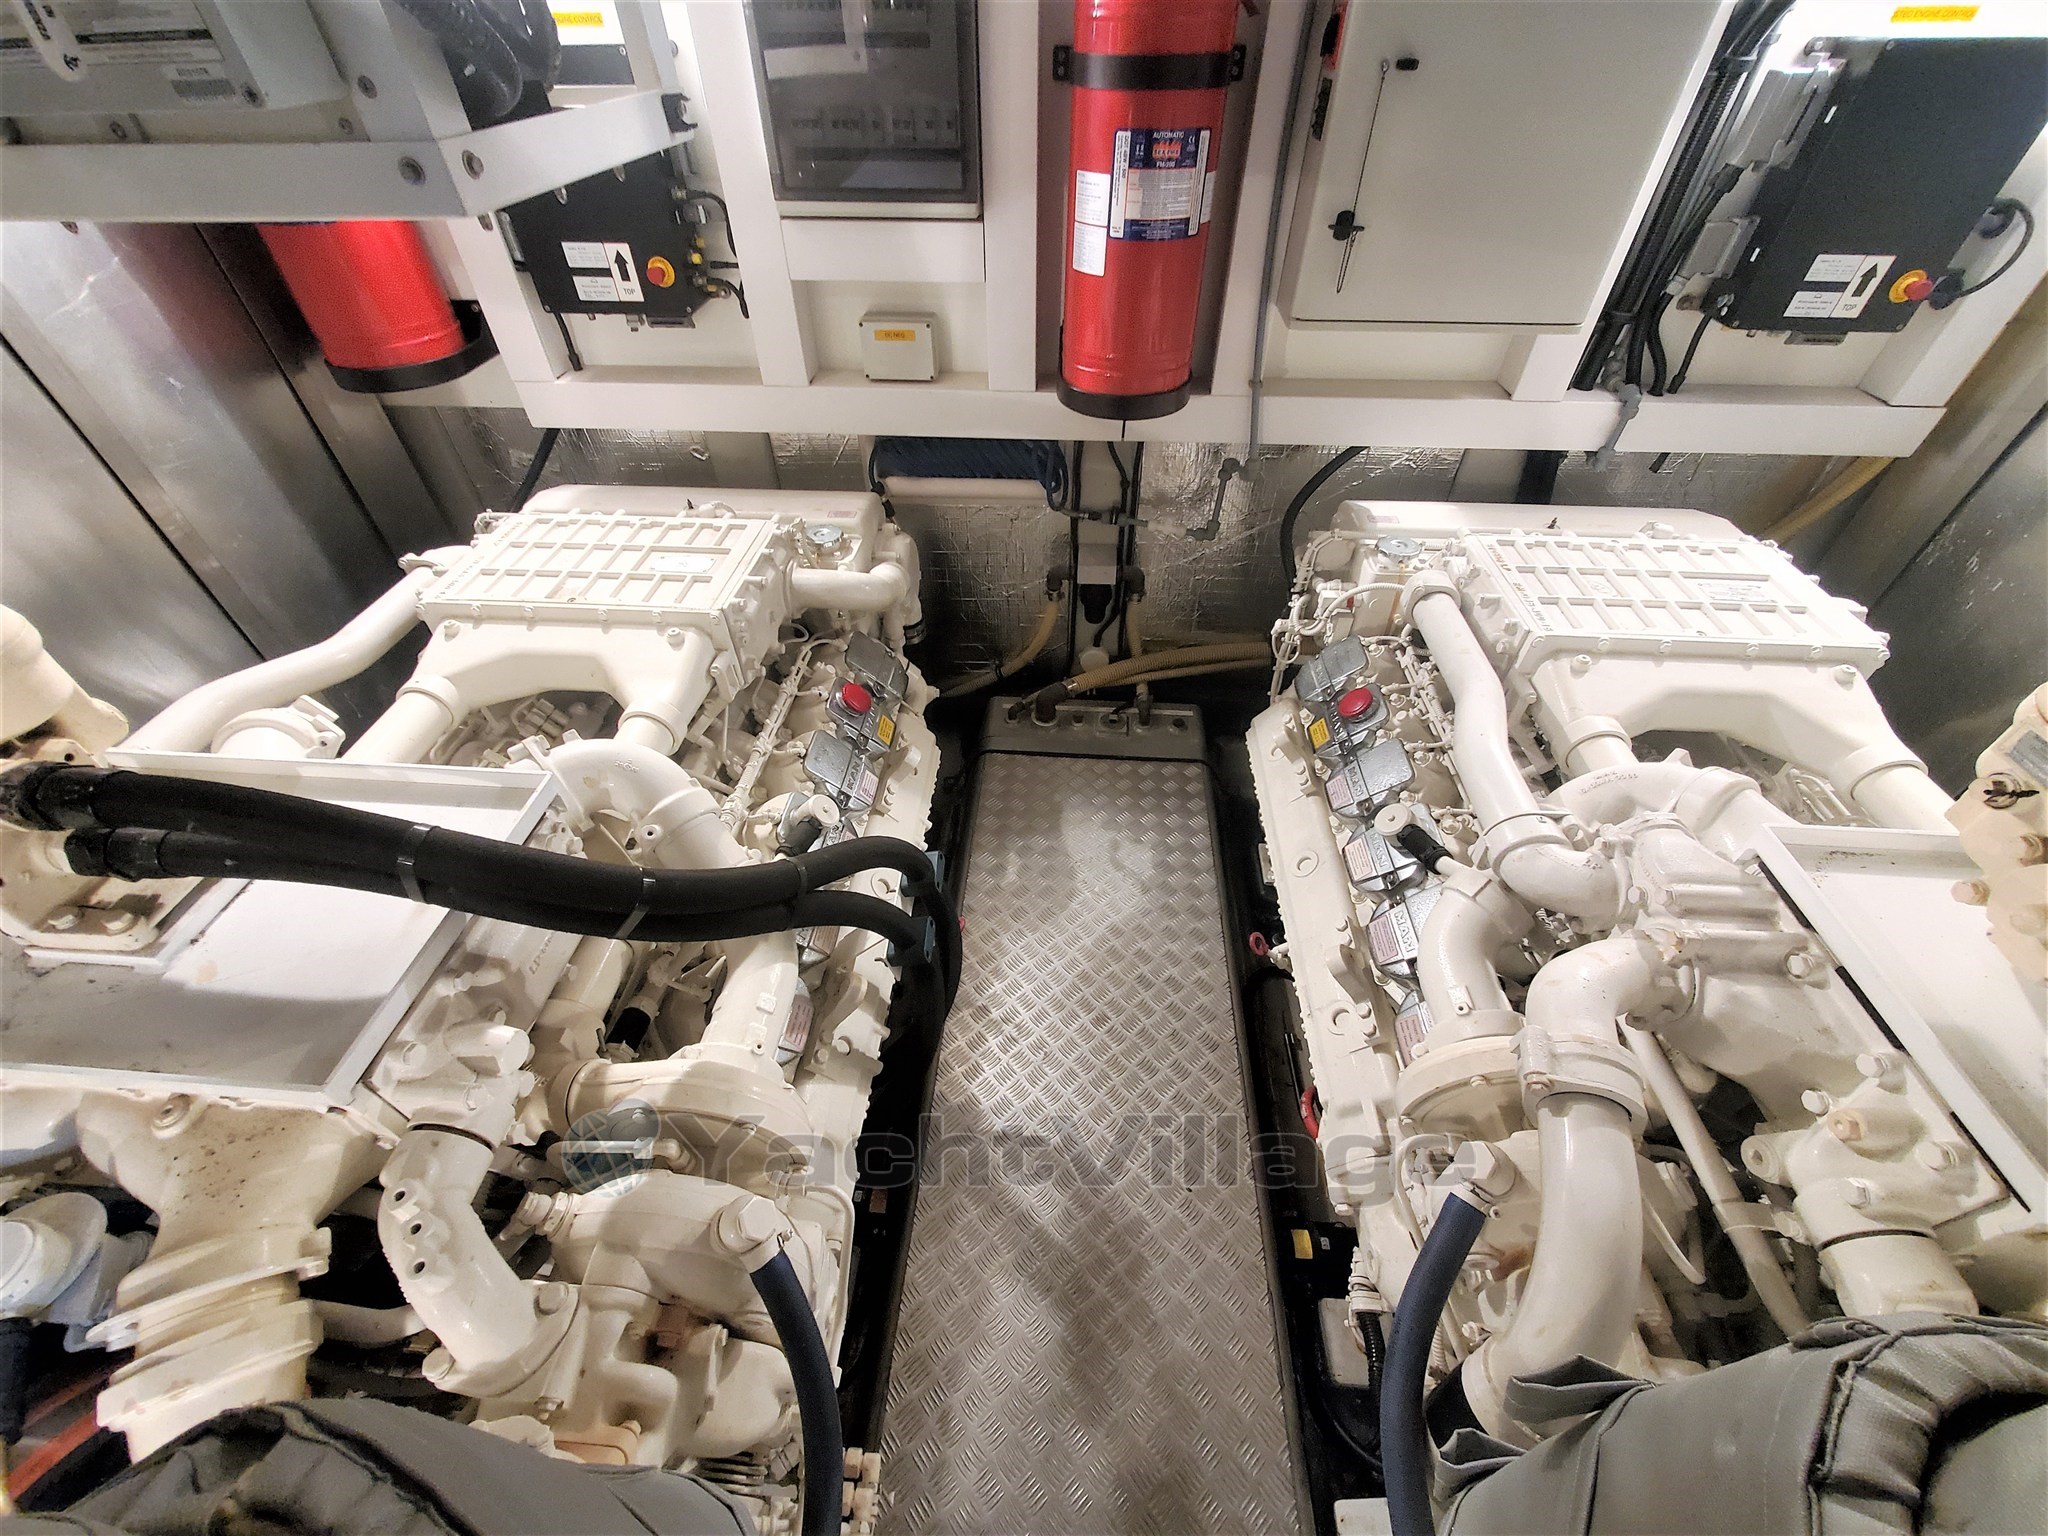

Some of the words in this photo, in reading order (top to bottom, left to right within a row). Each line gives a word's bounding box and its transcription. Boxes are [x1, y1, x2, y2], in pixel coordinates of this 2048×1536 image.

[1152, 131, 1185, 139] AUTOMATIC
[623, 288, 636, 296] TOP
[1842, 304, 1858, 312] TOP
[847, 760, 861, 791] MAN
[1348, 766, 1364, 797] MAN
[1370, 831, 1388, 869] MAN
[1394, 910, 1416, 953] MAN
